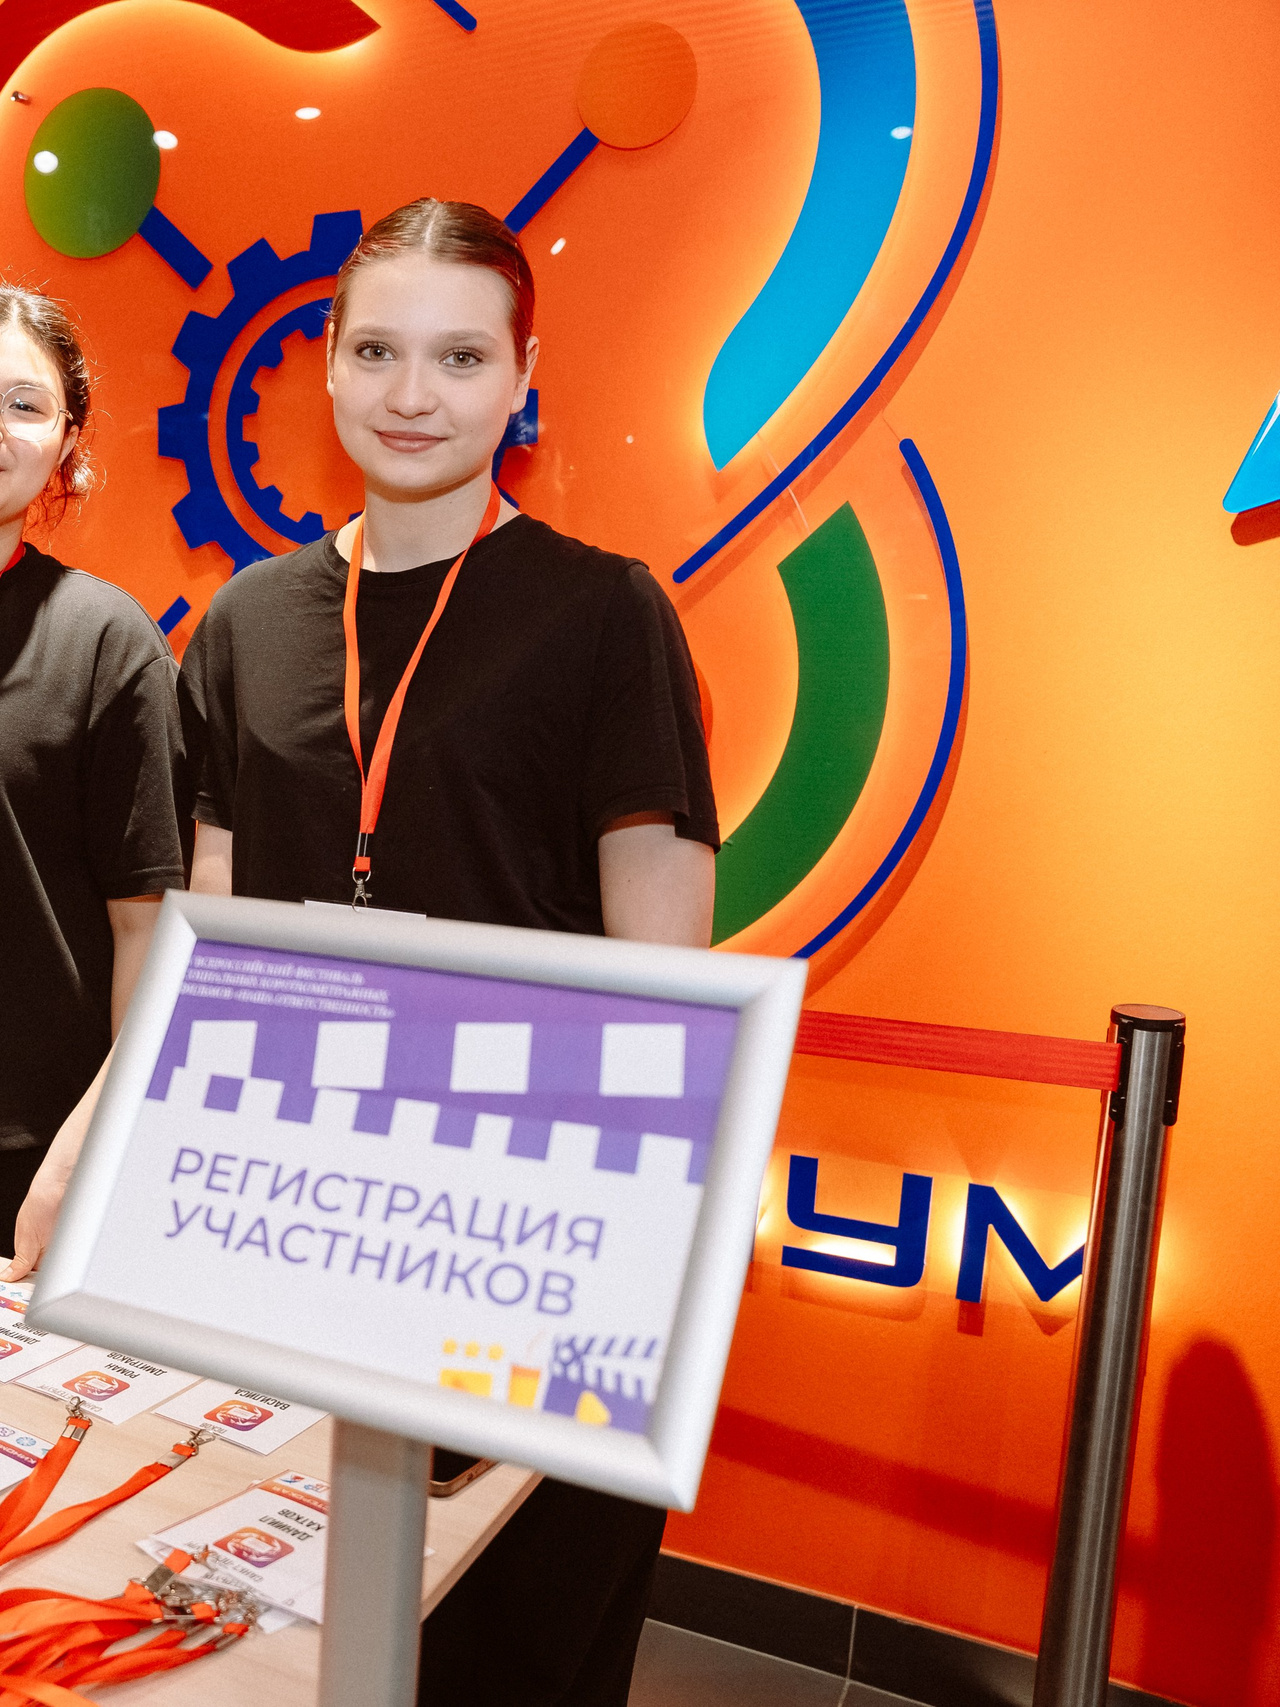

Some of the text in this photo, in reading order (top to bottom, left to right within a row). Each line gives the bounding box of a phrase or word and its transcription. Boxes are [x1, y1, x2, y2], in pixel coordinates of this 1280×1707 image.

[186, 968, 259, 988] ОЦИАЛЬНЫХ
[169, 1146, 605, 1262] РЕГИСТРАЦИЯ
[165, 1199, 576, 1317] УЧАСТНИКОВ
[12, 1321, 49, 1337] ИВАНОВ
[104, 1363, 140, 1380] РОМАН
[106, 1352, 169, 1378] ДМИТРАКОВ
[234, 1388, 290, 1411] ВАСИЛИСА
[258, 1515, 314, 1542] ДАНИИЛ
[278, 1508, 326, 1533] КАТКОВ
